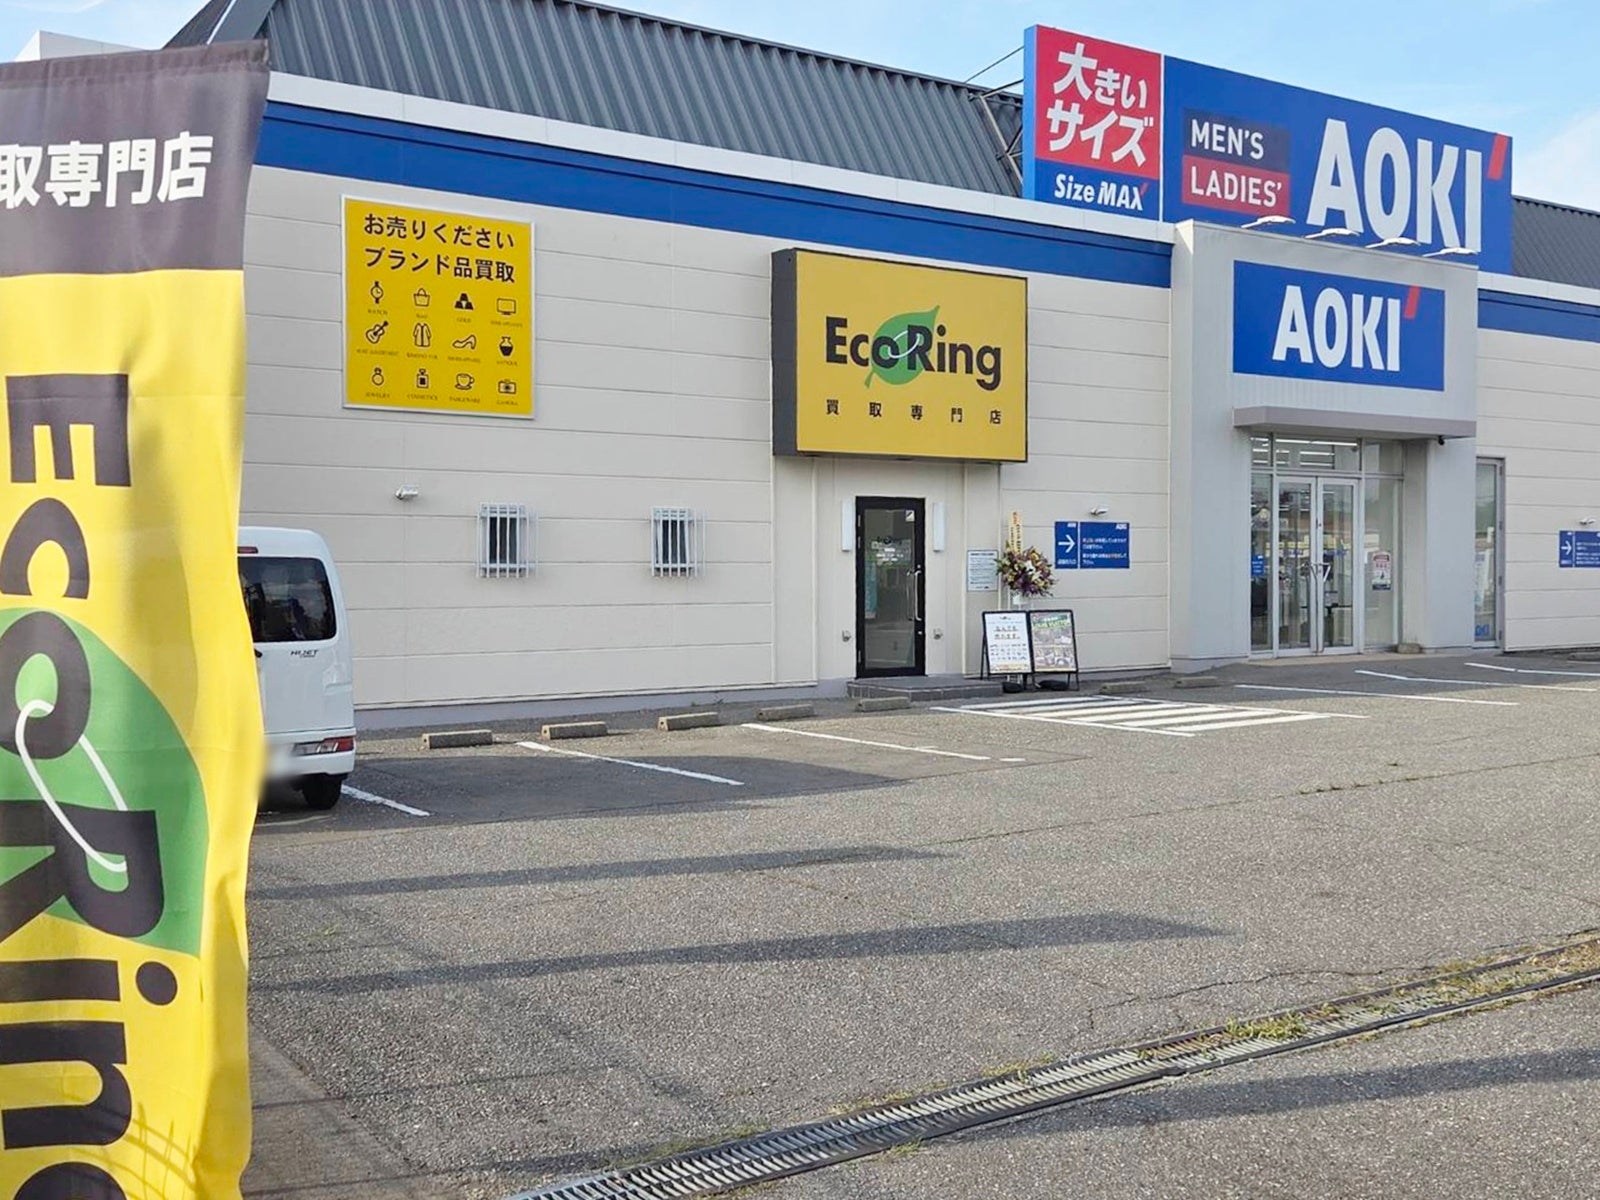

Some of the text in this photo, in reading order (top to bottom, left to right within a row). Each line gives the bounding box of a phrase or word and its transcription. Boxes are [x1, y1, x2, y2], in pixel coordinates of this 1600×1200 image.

[1053, 41, 1148, 109] 大きい
[1046, 98, 1154, 167] サイズ
[1191, 118, 1264, 160] MEN'S
[0, 131, 214, 210] 取専門店
[1191, 166, 1282, 207] LADIES'
[1054, 173, 1144, 211] Size MAX
[364, 213, 514, 249] お売りください
[365, 247, 515, 283] ブランド品買取
[826, 399, 1001, 424] 買取専門店
[0, 373, 178, 1200] EcoRin
